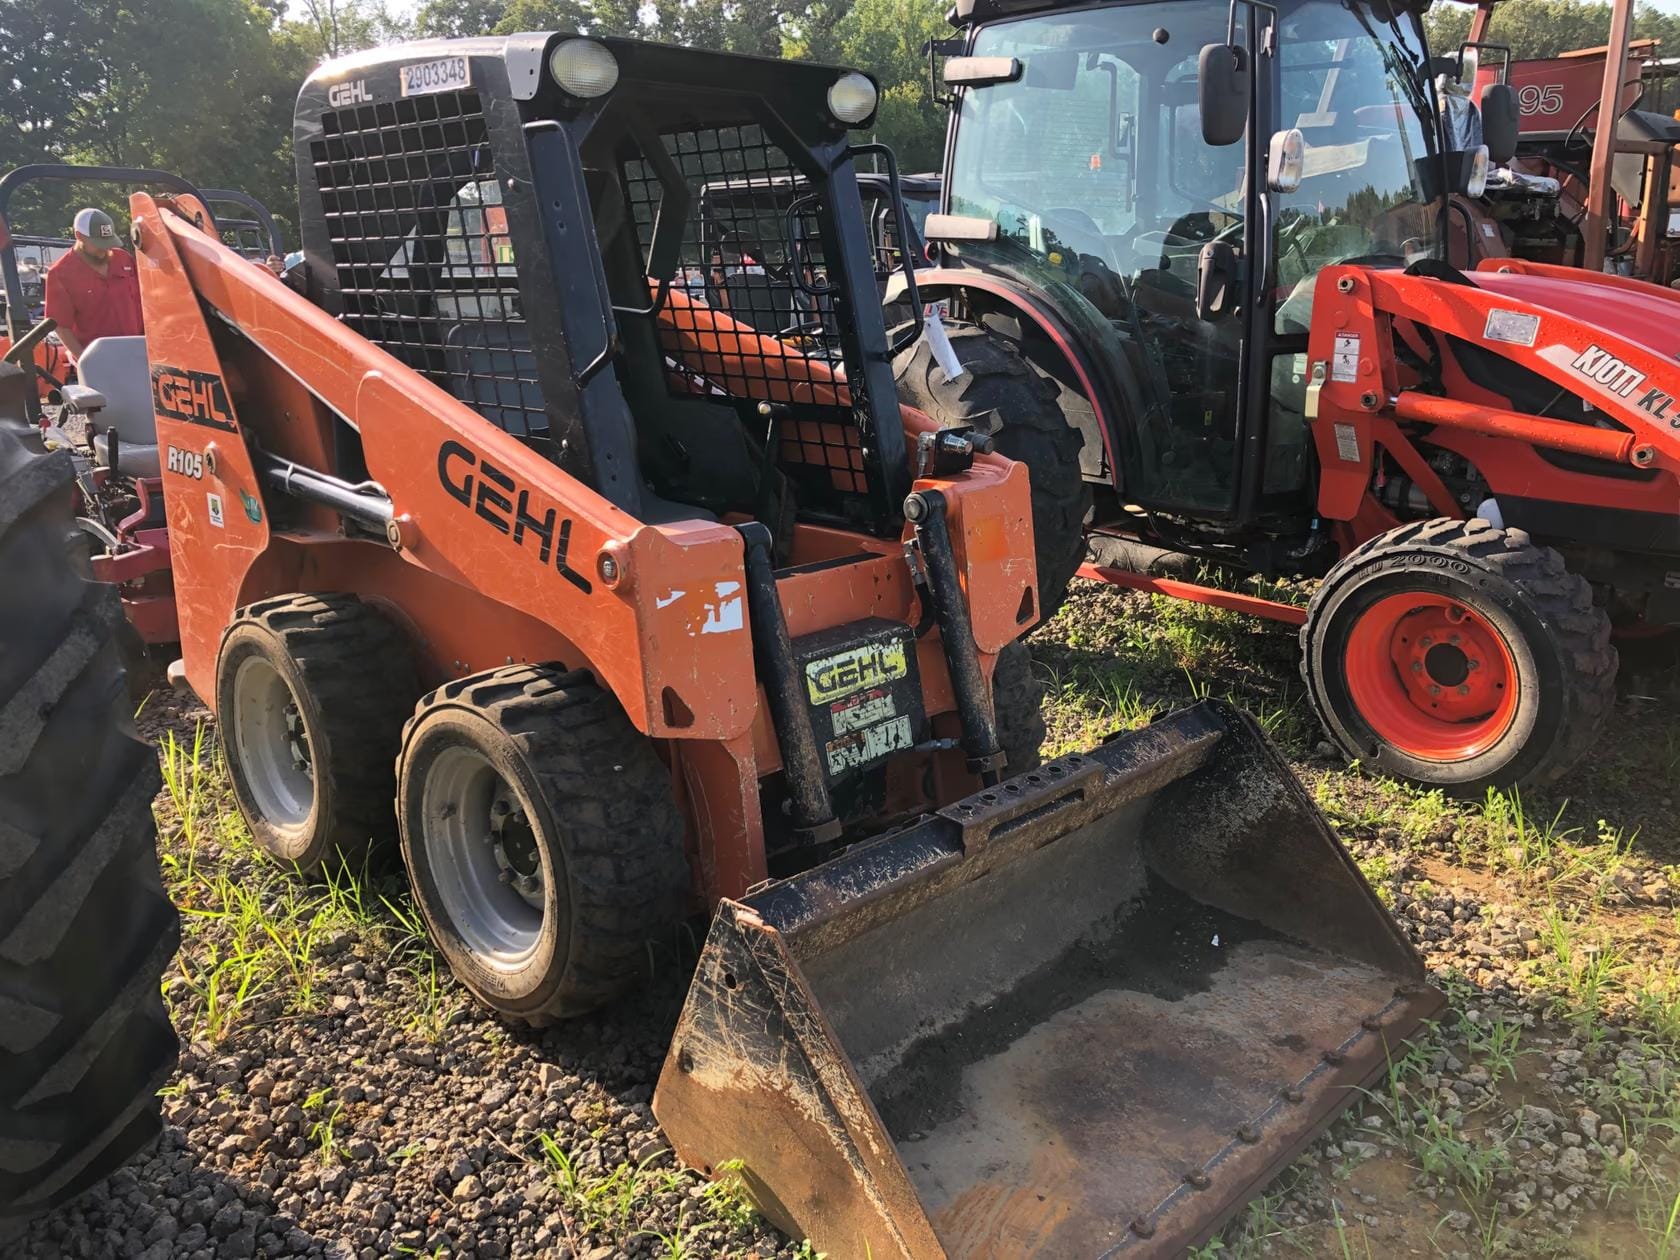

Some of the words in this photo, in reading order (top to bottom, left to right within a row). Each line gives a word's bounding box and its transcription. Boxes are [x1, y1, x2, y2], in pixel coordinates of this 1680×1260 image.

[328, 79, 373, 107] GEHL
[406, 58, 466, 90] 2903348
[1518, 84, 1564, 116] 95
[158, 374, 227, 423] GEHL
[1571, 343, 1648, 399] KIOTI
[1637, 388, 1674, 420] KL
[167, 444, 203, 480] R105
[437, 439, 593, 595] GEHL
[814, 649, 898, 694] GEHL
